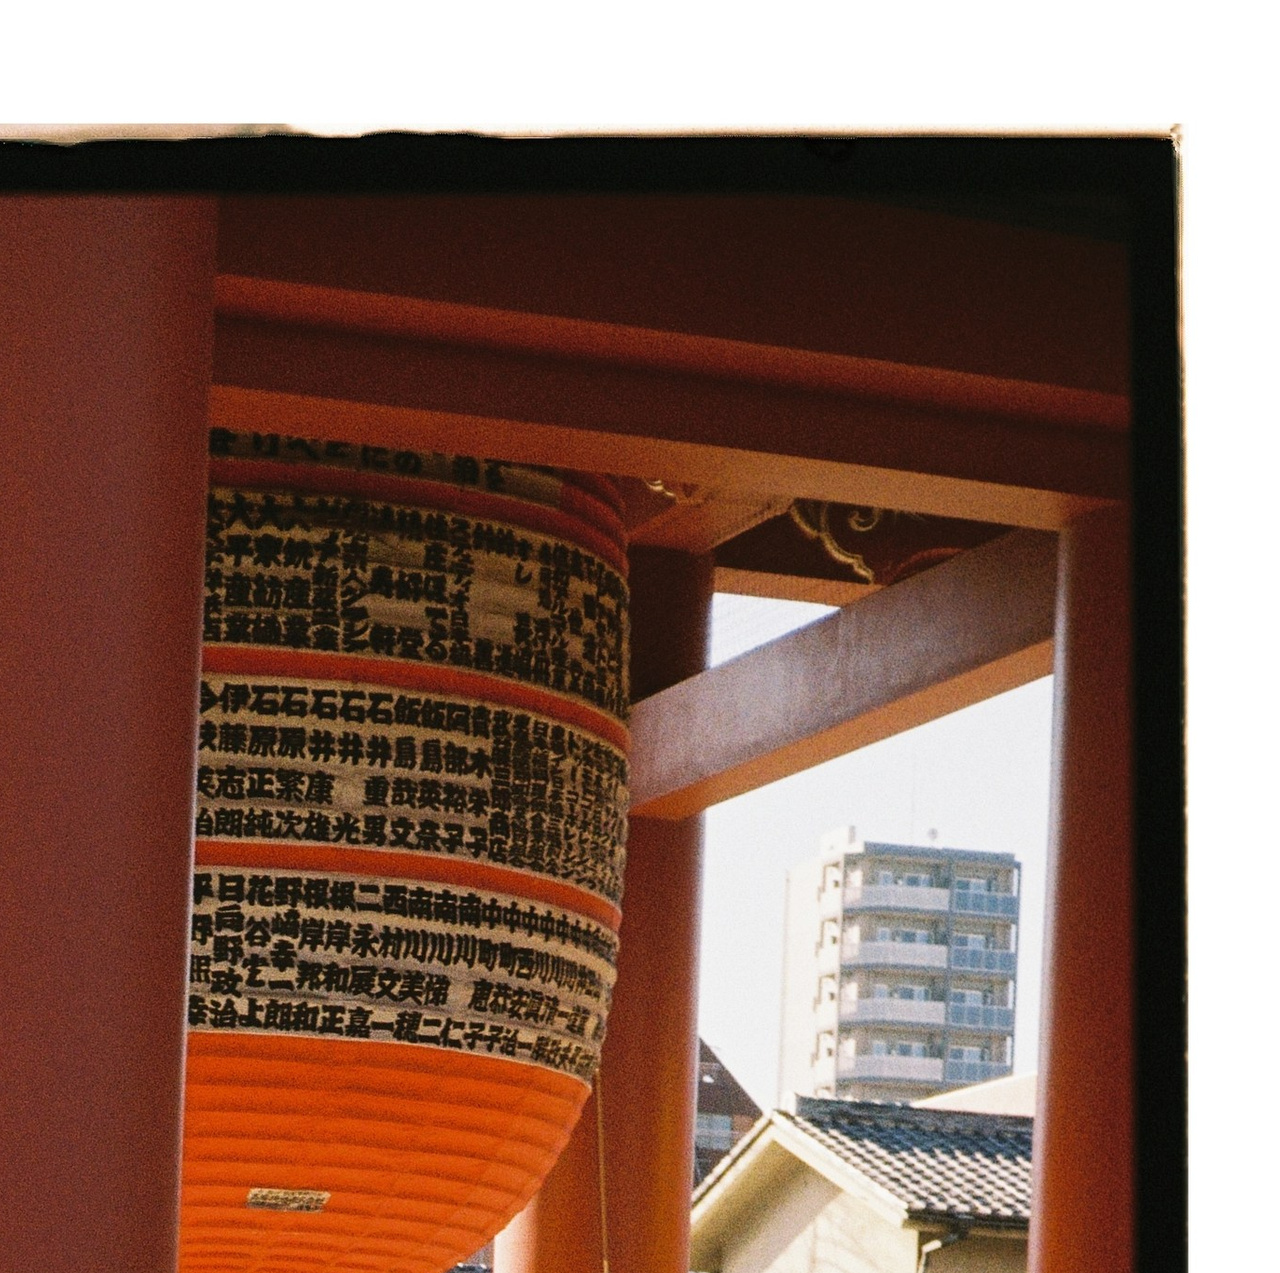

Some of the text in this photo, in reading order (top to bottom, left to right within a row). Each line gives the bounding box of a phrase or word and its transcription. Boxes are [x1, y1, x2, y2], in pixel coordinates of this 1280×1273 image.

[244, 685, 279, 838] 石原正純
[363, 692, 393, 847] 石井重男
[320, 881, 356, 1035] 根岸和正
[370, 885, 408, 1033] 西村文一
